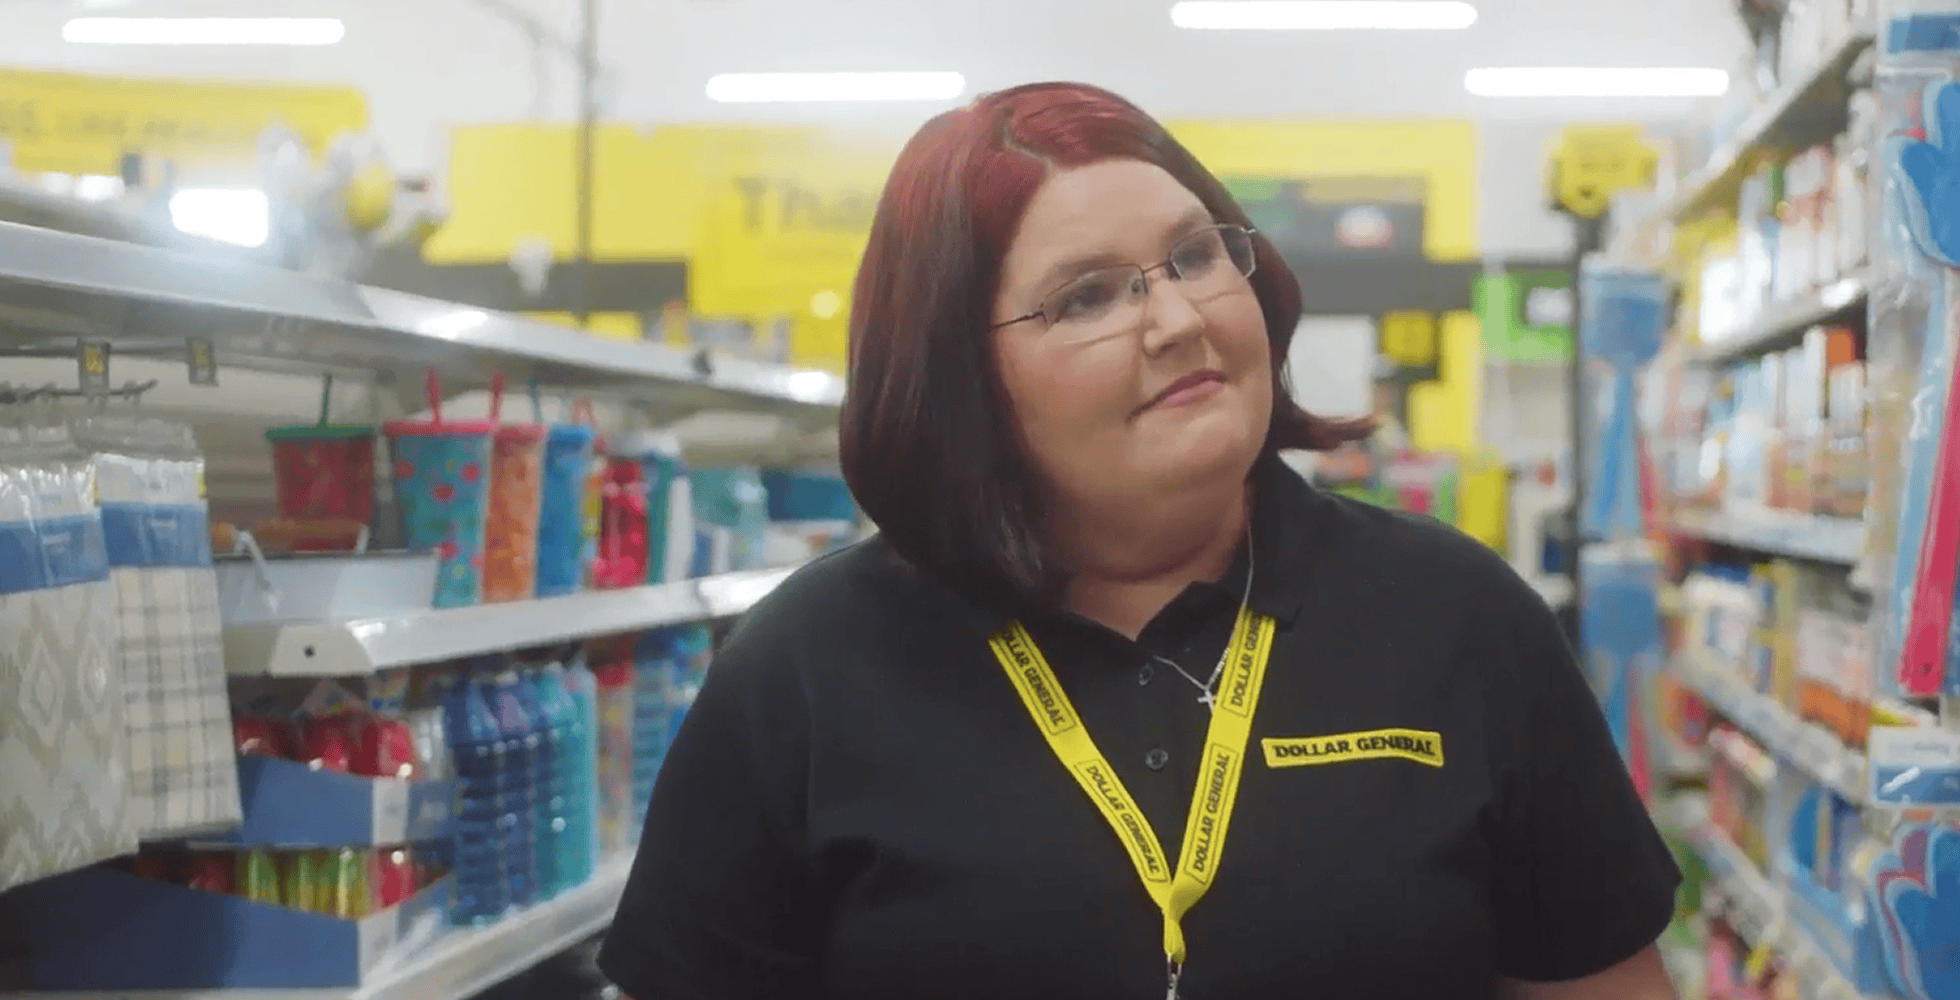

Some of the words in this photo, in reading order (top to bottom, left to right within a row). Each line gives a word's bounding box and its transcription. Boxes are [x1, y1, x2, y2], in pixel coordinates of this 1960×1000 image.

[731, 175, 876, 233] Tha
[1024, 667, 1065, 726] GENERAL
[1230, 653, 1252, 706] DOLLAR
[1273, 740, 1352, 757] DOLLAR
[1356, 735, 1436, 756] GENERAL
[1086, 766, 1125, 810] DOLLAR
[1121, 813, 1160, 873] GENERAL
[1193, 815, 1214, 872] DOLLAR
[1206, 751, 1230, 814] GENERAL
